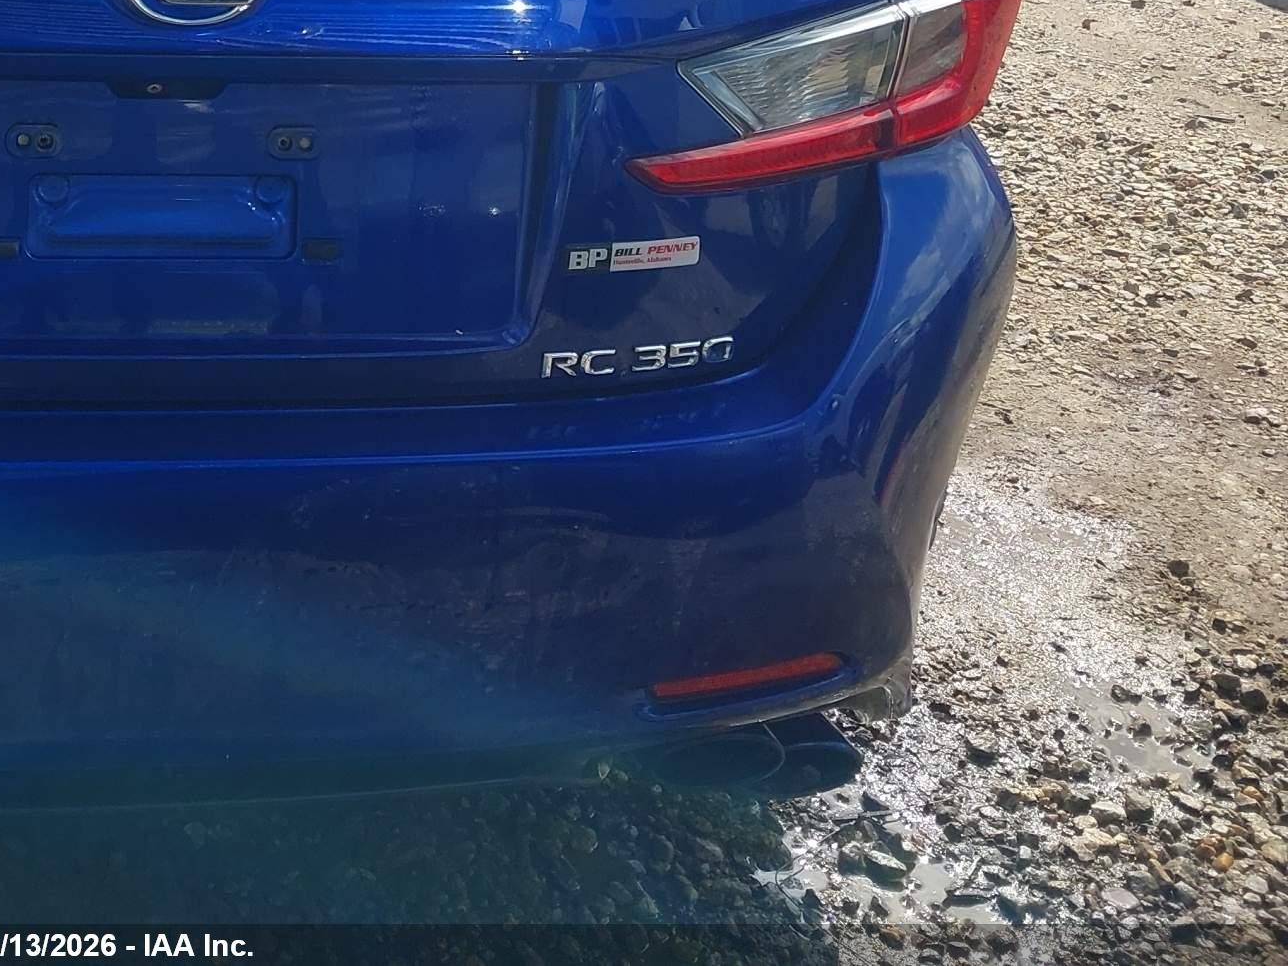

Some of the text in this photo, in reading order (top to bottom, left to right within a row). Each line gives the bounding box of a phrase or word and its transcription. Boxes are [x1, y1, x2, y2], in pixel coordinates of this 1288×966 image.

[568, 248, 608, 270] BP
[613, 240, 698, 258] BILL PENNEY
[541, 335, 735, 379] RC 350
